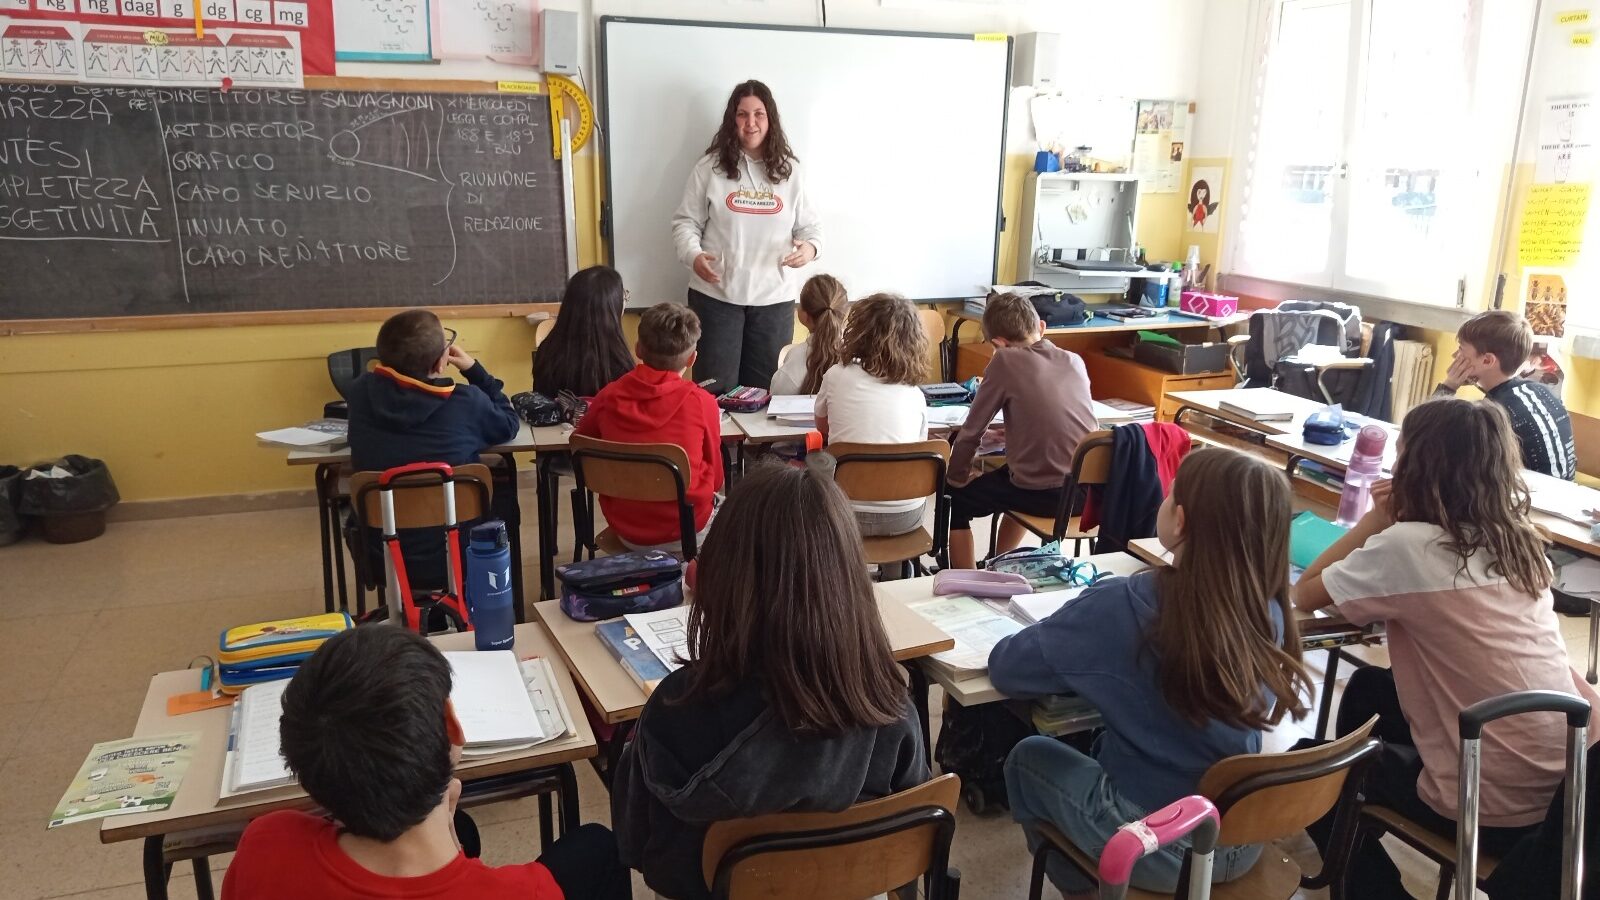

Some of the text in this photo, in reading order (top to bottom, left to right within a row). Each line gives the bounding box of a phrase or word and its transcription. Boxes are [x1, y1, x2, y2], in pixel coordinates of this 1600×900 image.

[125, 0, 155, 15] dag
[173, 3, 183, 17] g
[207, 3, 227, 20] dg
[245, 8, 263, 22] cg
[279, 10, 304, 25] mg
[1560, 14, 1588, 23] CURTAIN
[158, 88, 434, 111] DIRETTORE SALVAGNONI
[164, 121, 324, 141] ART DIRECTOR
[172, 152, 274, 171] GRAFICO
[459, 170, 537, 188] RIUNIONE
[177, 181, 372, 202] CAPO SERVIZIO
[466, 192, 483, 204] DI
[187, 217, 287, 237] INVIATO
[464, 216, 543, 232] REDAZIONE
[187, 244, 246, 267] CAPO
